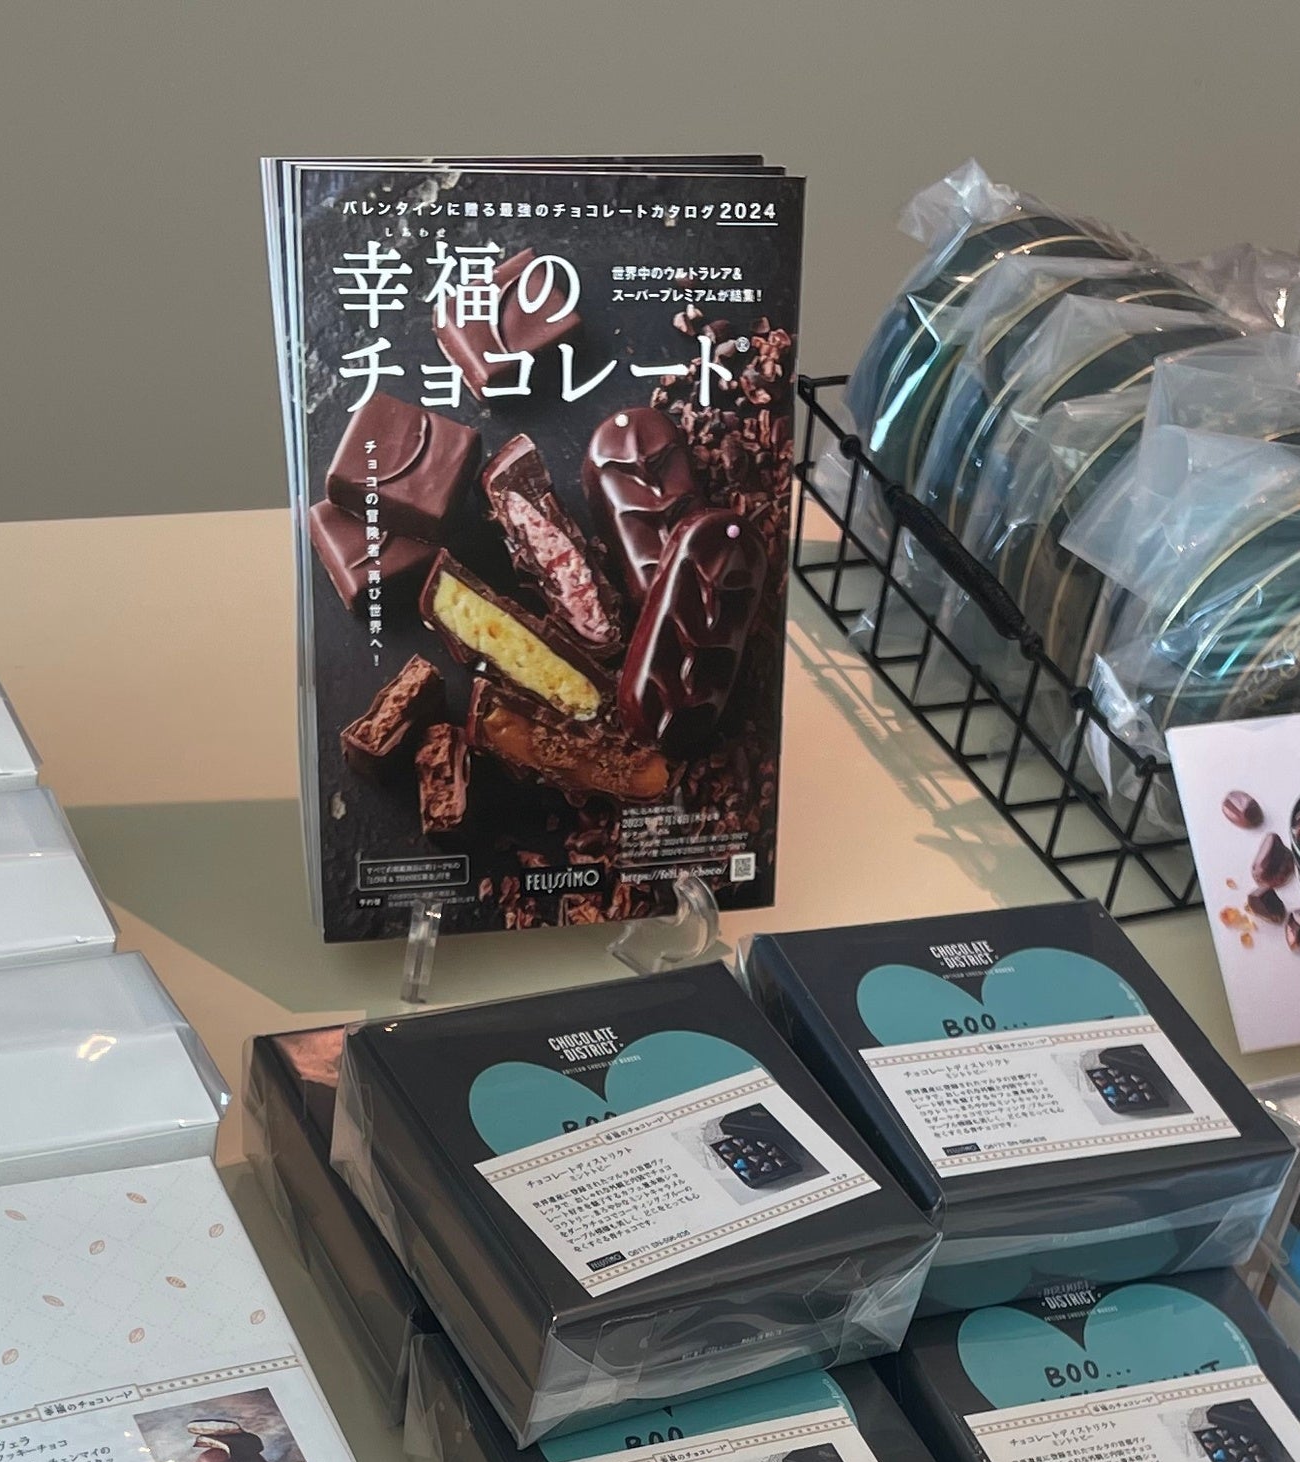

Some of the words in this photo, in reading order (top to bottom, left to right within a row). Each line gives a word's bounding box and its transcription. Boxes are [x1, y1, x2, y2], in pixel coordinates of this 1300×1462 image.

[719, 201, 778, 221] 2024
[332, 239, 582, 330] 幸福の
[338, 334, 733, 413] チョコレート
[525, 867, 600, 893] FELISSIMO
[929, 939, 995, 960] CHOCOLATE
[943, 951, 994, 970] DISTRICT
[547, 1026, 619, 1052] CHOCOLATE
[563, 1040, 618, 1063] DISTRICT
[1044, 1289, 1097, 1311] DISTRICT
